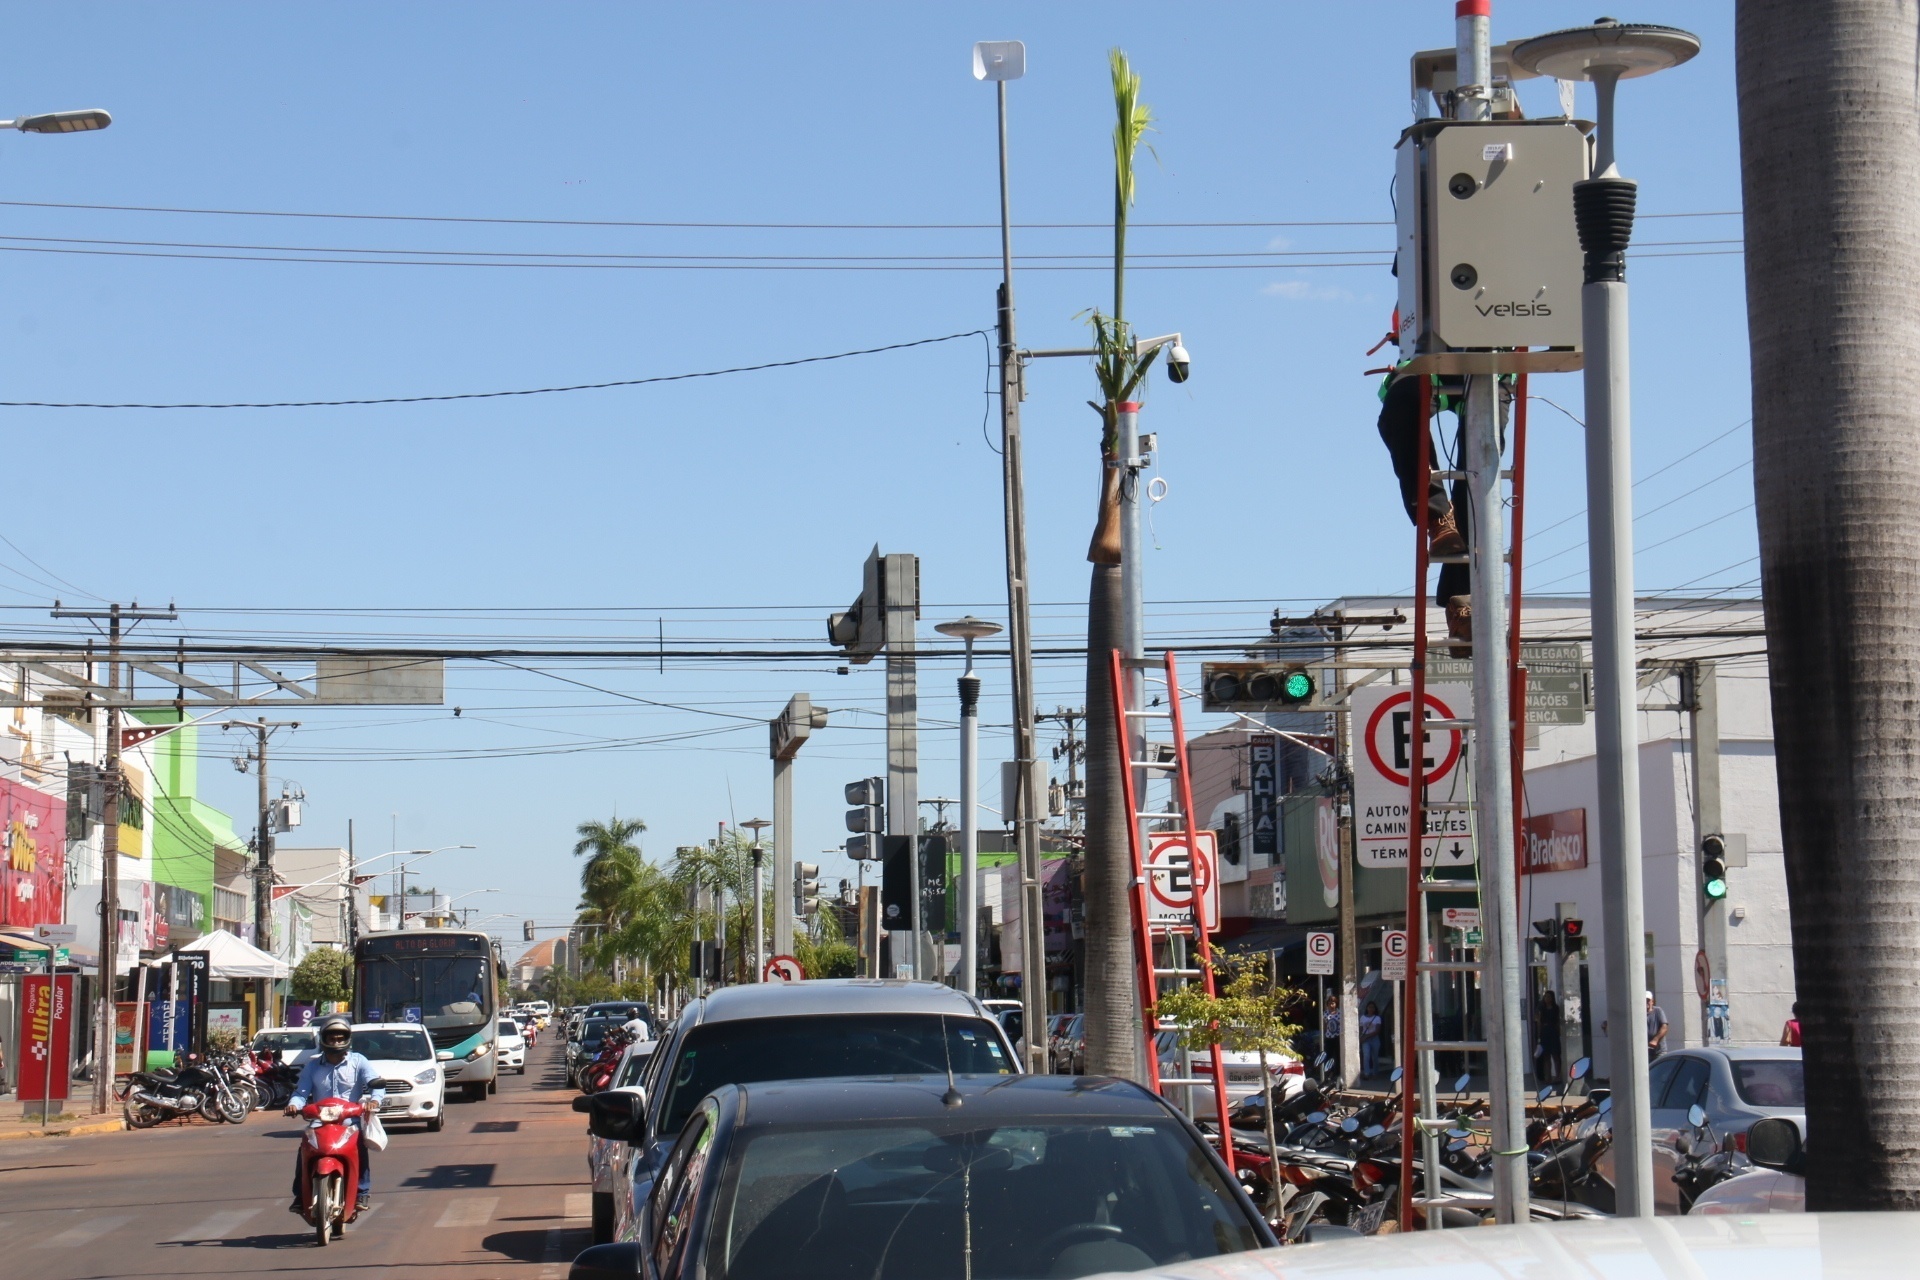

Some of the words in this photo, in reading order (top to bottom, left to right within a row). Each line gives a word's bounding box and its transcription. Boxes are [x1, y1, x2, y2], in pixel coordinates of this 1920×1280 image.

[1475, 300, 1552, 318] velsis
[1520, 647, 1578, 660] ALLEGARO
[1535, 661, 1576, 674] UNICEN
[1253, 746, 1275, 831] BAHIA
[1371, 846, 1433, 859] TÉRMO
[1530, 829, 1581, 867] Bradesco
[1168, 854, 1193, 893] E
[1316, 938, 1325, 952] E
[1392, 937, 1402, 952] E
[28, 983, 36, 1014] Drogarias
[53, 985, 64, 1020] Popular
[31, 985, 51, 1042] Ultra
